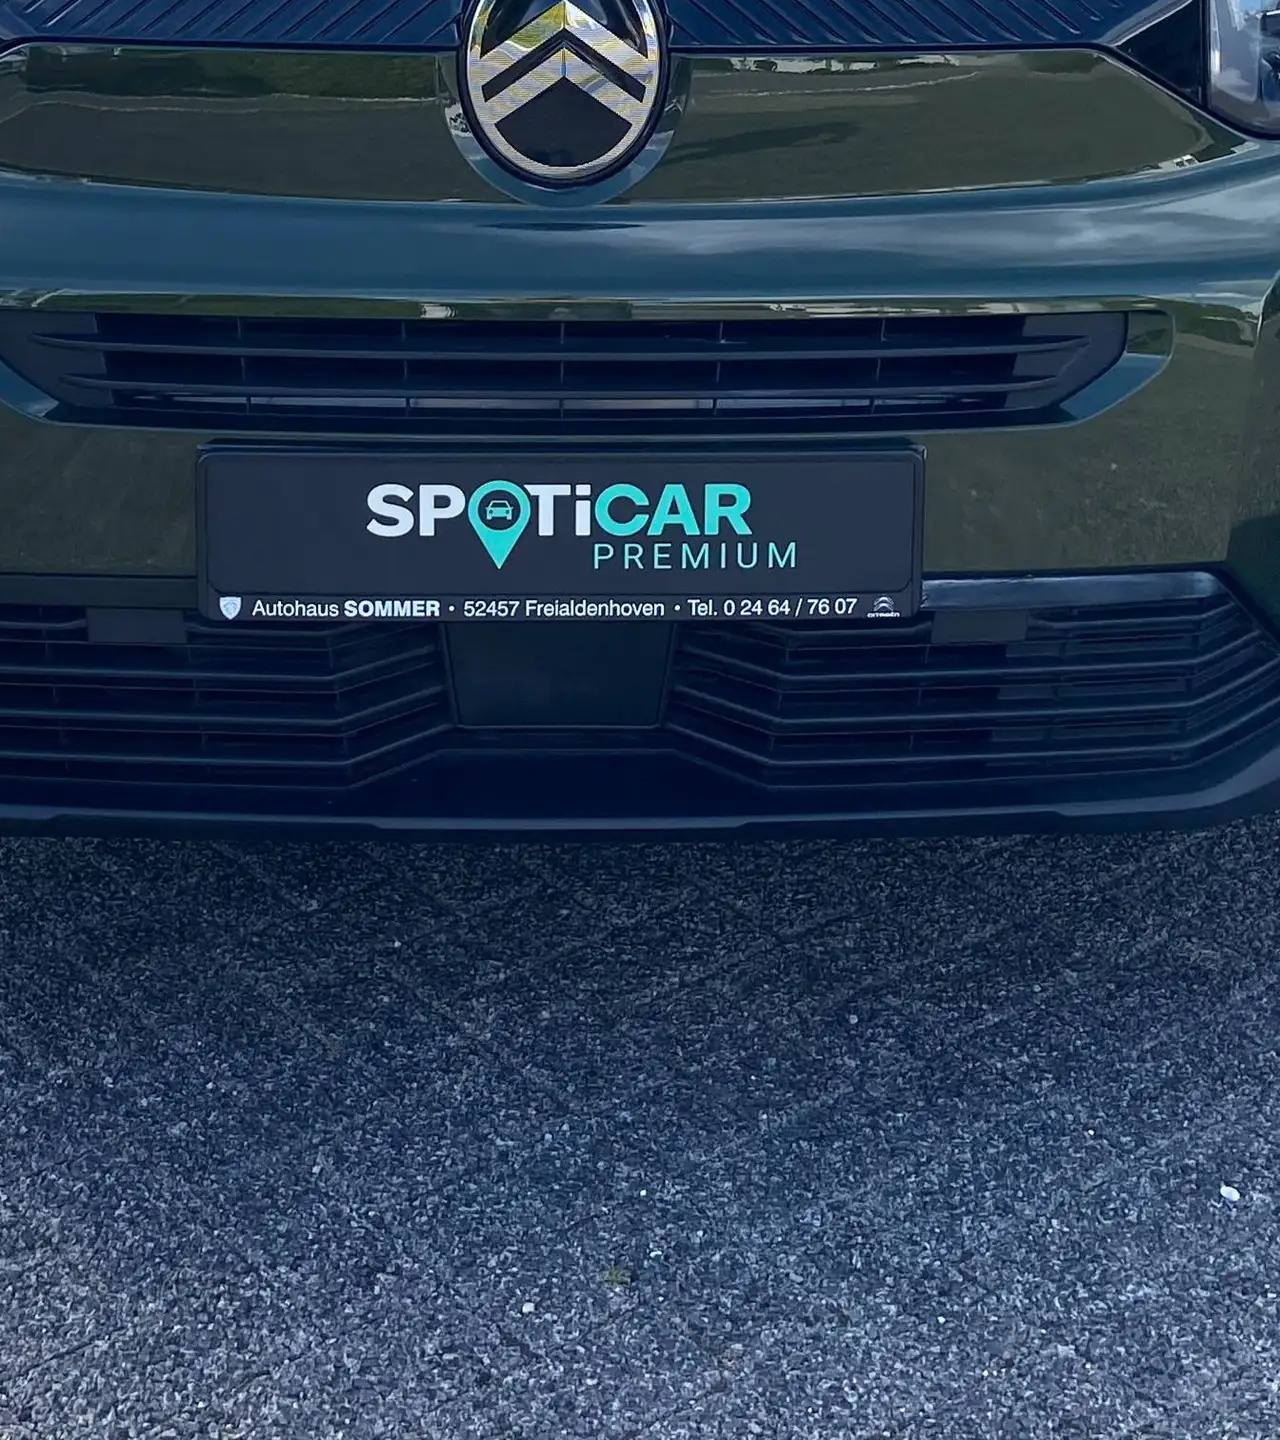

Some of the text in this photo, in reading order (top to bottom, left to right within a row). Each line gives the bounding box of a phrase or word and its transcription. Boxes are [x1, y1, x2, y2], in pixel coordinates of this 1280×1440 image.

[593, 542, 797, 570] PREMIUM
[252, 599, 339, 618] Autohaus
[343, 599, 440, 618] SOMMER
[463, 600, 520, 617] 52457
[525, 599, 665, 617] Freialdenhoven
[687, 599, 718, 616] Tel.
[740, 598, 764, 616] 24
[767, 598, 791, 615] 64
[807, 598, 830, 615] 76
[834, 597, 858, 614] 07
